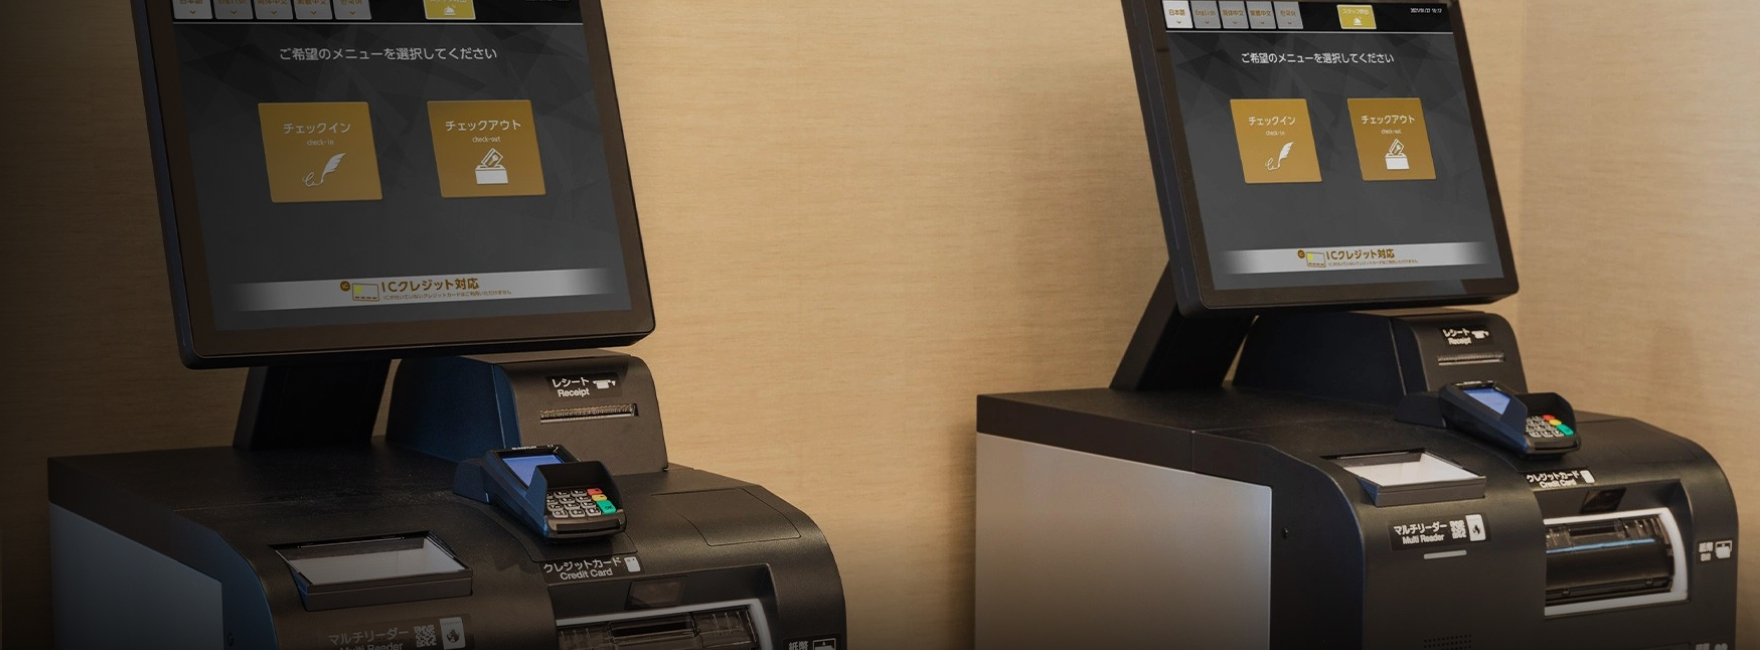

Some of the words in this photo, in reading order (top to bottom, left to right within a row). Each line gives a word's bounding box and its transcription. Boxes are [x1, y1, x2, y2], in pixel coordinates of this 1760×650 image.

[279, 47, 498, 61] ご希望のメニューを選択してください
[1241, 53, 1395, 64] ご希望のメニューを選択してください
[445, 119, 522, 132] チェックアウト
[1248, 116, 1296, 126] チェックイン
[1360, 114, 1416, 125] チェックアウト
[283, 122, 351, 134] チェックイン
[306, 138, 335, 146] check-in
[1325, 248, 1396, 260] ICクレジット対応
[381, 277, 480, 293] ICクレジット対応
[1443, 328, 1471, 338] レシート
[1448, 336, 1472, 345] Receipt
[552, 377, 590, 388] レシート
[557, 388, 590, 398] Receipt
[1526, 470, 1580, 482] クレジットカード
[1539, 480, 1560, 489] Credit
[1560, 479, 1577, 487] Card
[1393, 521, 1448, 535] マルチリーダー
[1402, 535, 1420, 545] Multi
[1420, 533, 1445, 543] Reader
[543, 556, 622, 573] クレジットカード
[560, 570, 589, 580] Credit
[590, 568, 613, 577] Card
[328, 627, 409, 645] マルチリーダー
